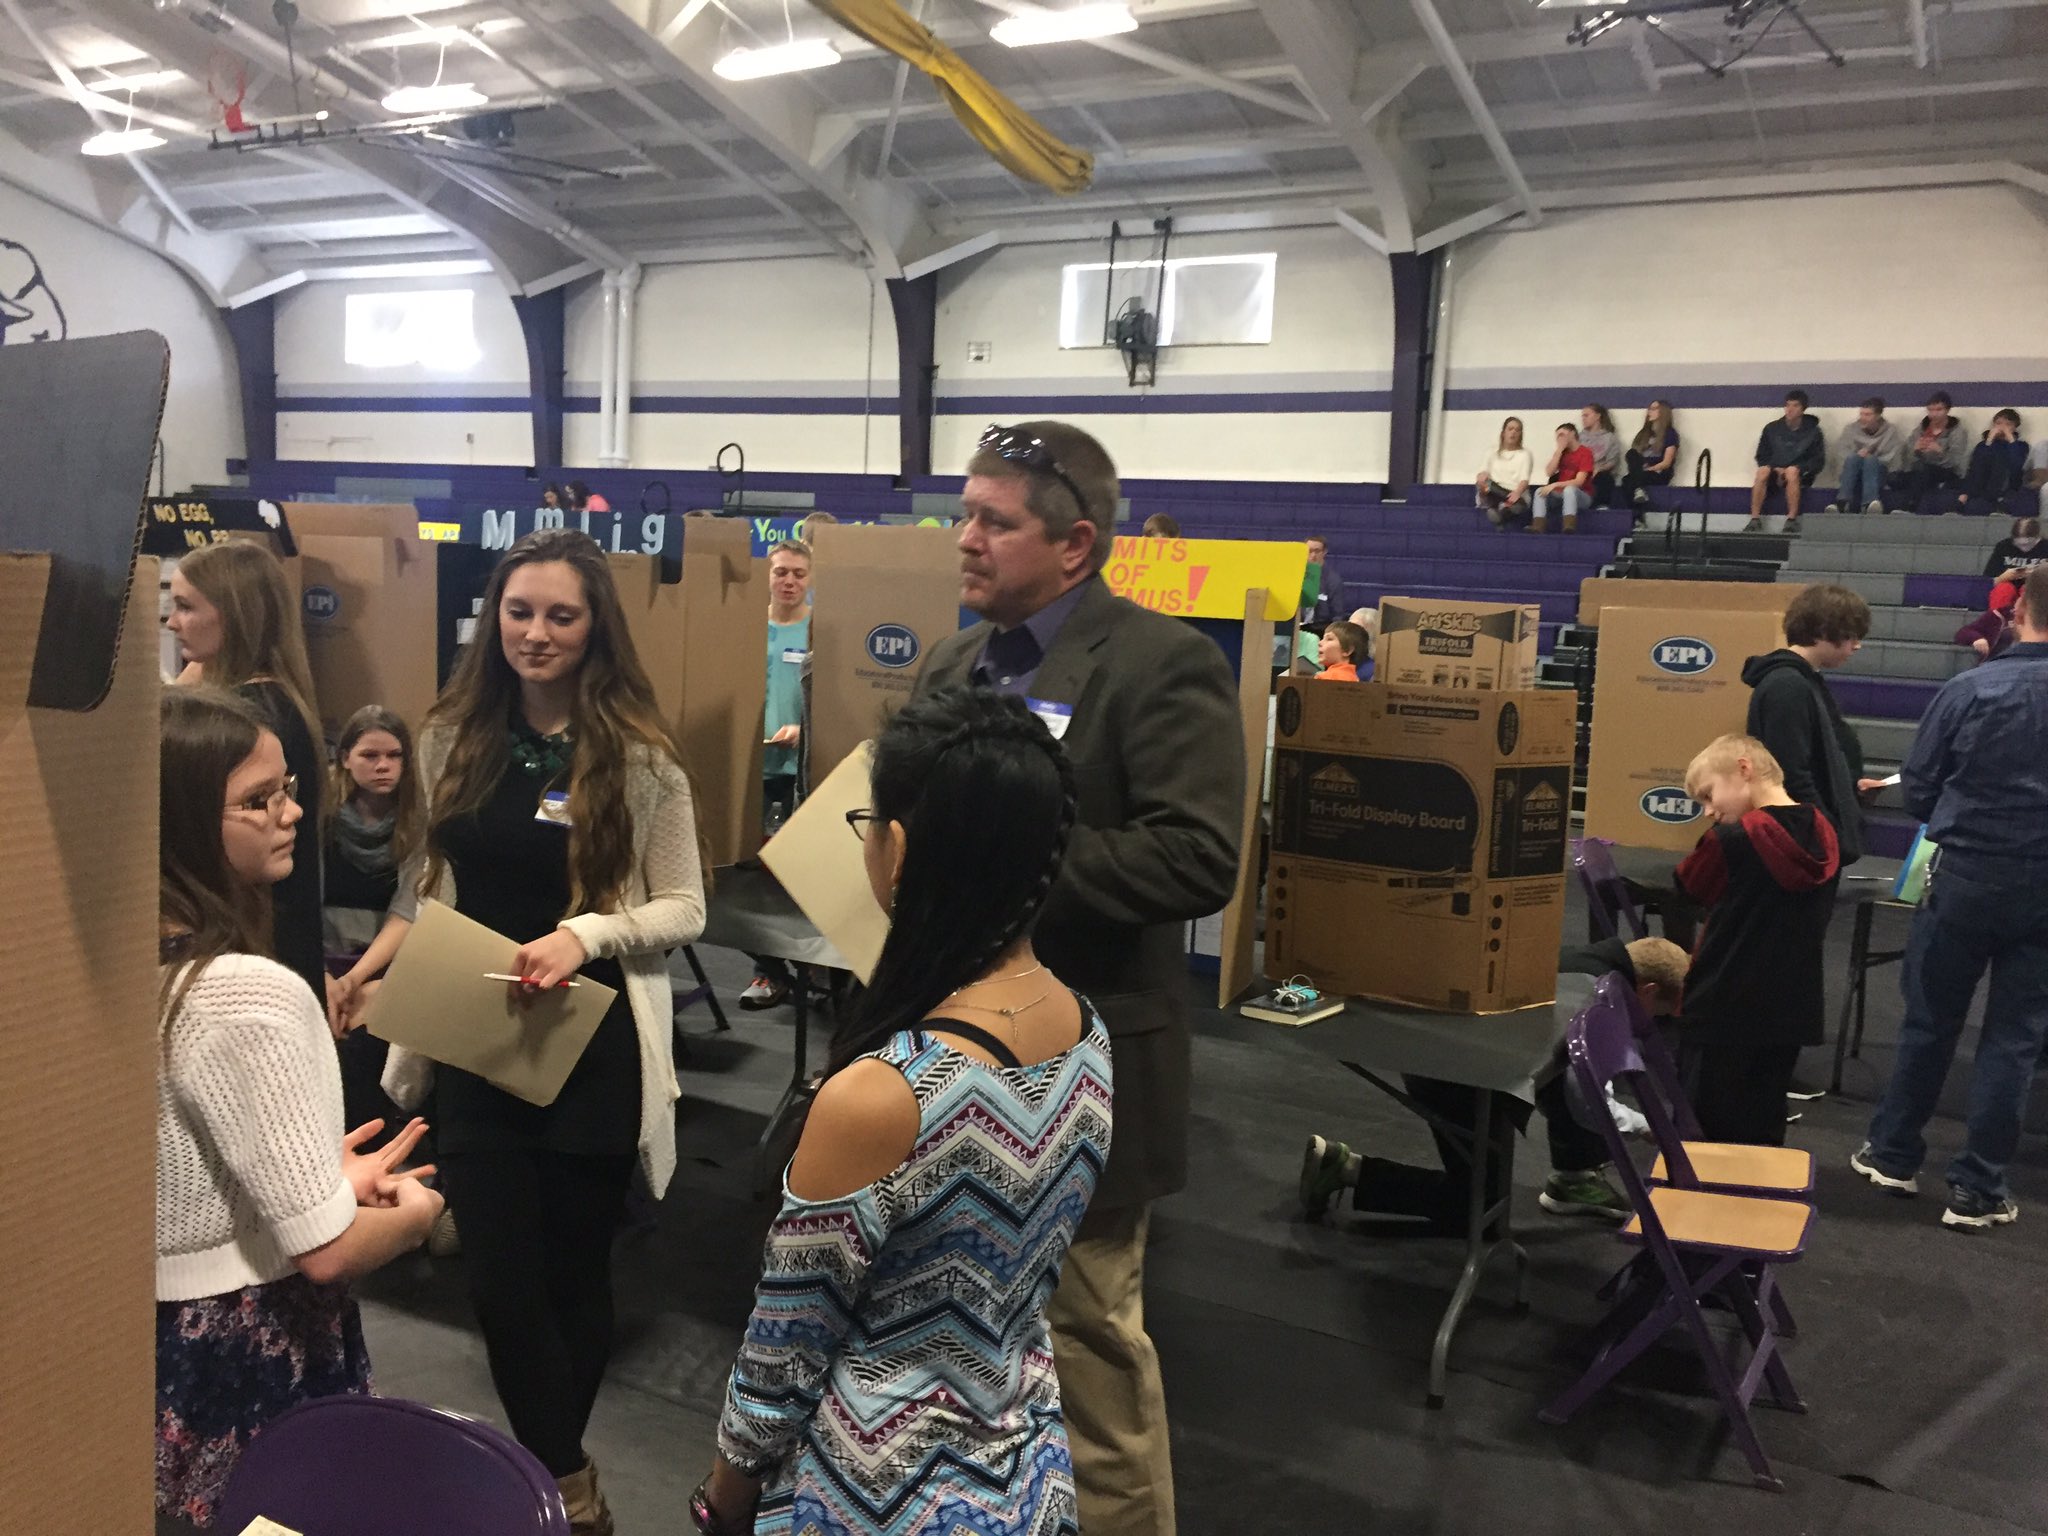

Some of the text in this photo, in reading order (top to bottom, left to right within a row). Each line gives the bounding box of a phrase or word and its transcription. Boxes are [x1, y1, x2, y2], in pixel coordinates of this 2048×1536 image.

[153, 503, 214, 525] NO EGG,
[184, 529, 207, 549] NO
[754, 518, 786, 542] You
[1113, 538, 1188, 562] MITS
[1110, 563, 1149, 586] OF
[1416, 611, 1482, 632] ArtSkills
[1424, 636, 1470, 649] TRIFOLD
[1309, 799, 1466, 831] Tri-Fold Display Board
[1521, 817, 1558, 832] Tri-Fold
